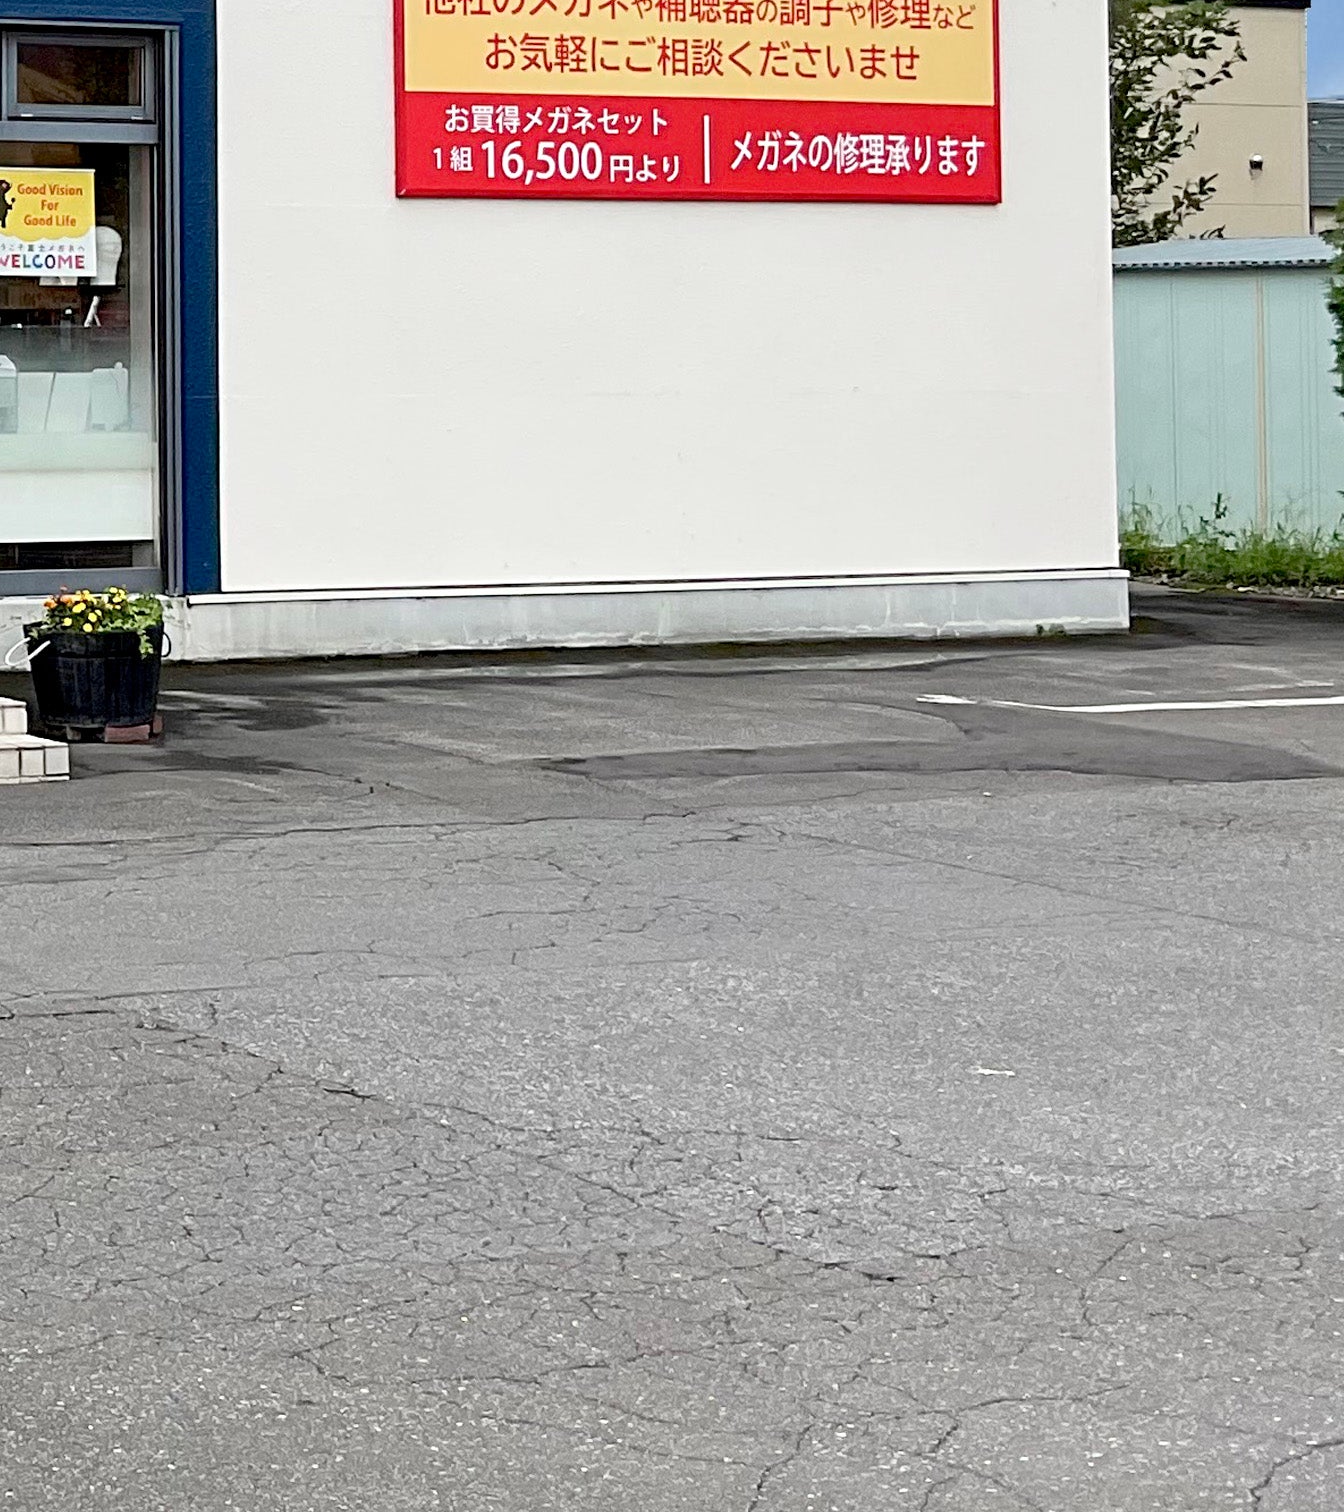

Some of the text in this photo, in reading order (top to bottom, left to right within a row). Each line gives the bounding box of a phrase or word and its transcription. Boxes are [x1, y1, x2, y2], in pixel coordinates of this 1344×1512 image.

[485, 32, 920, 80] お気軽にご相談くださいませ
[444, 104, 667, 135] お買得メガネセット
[731, 129, 985, 176] メガネの修理承ります
[17, 183, 83, 196] Good Vision
[41, 199, 59, 211] For
[24, 214, 76, 226] Good Life
